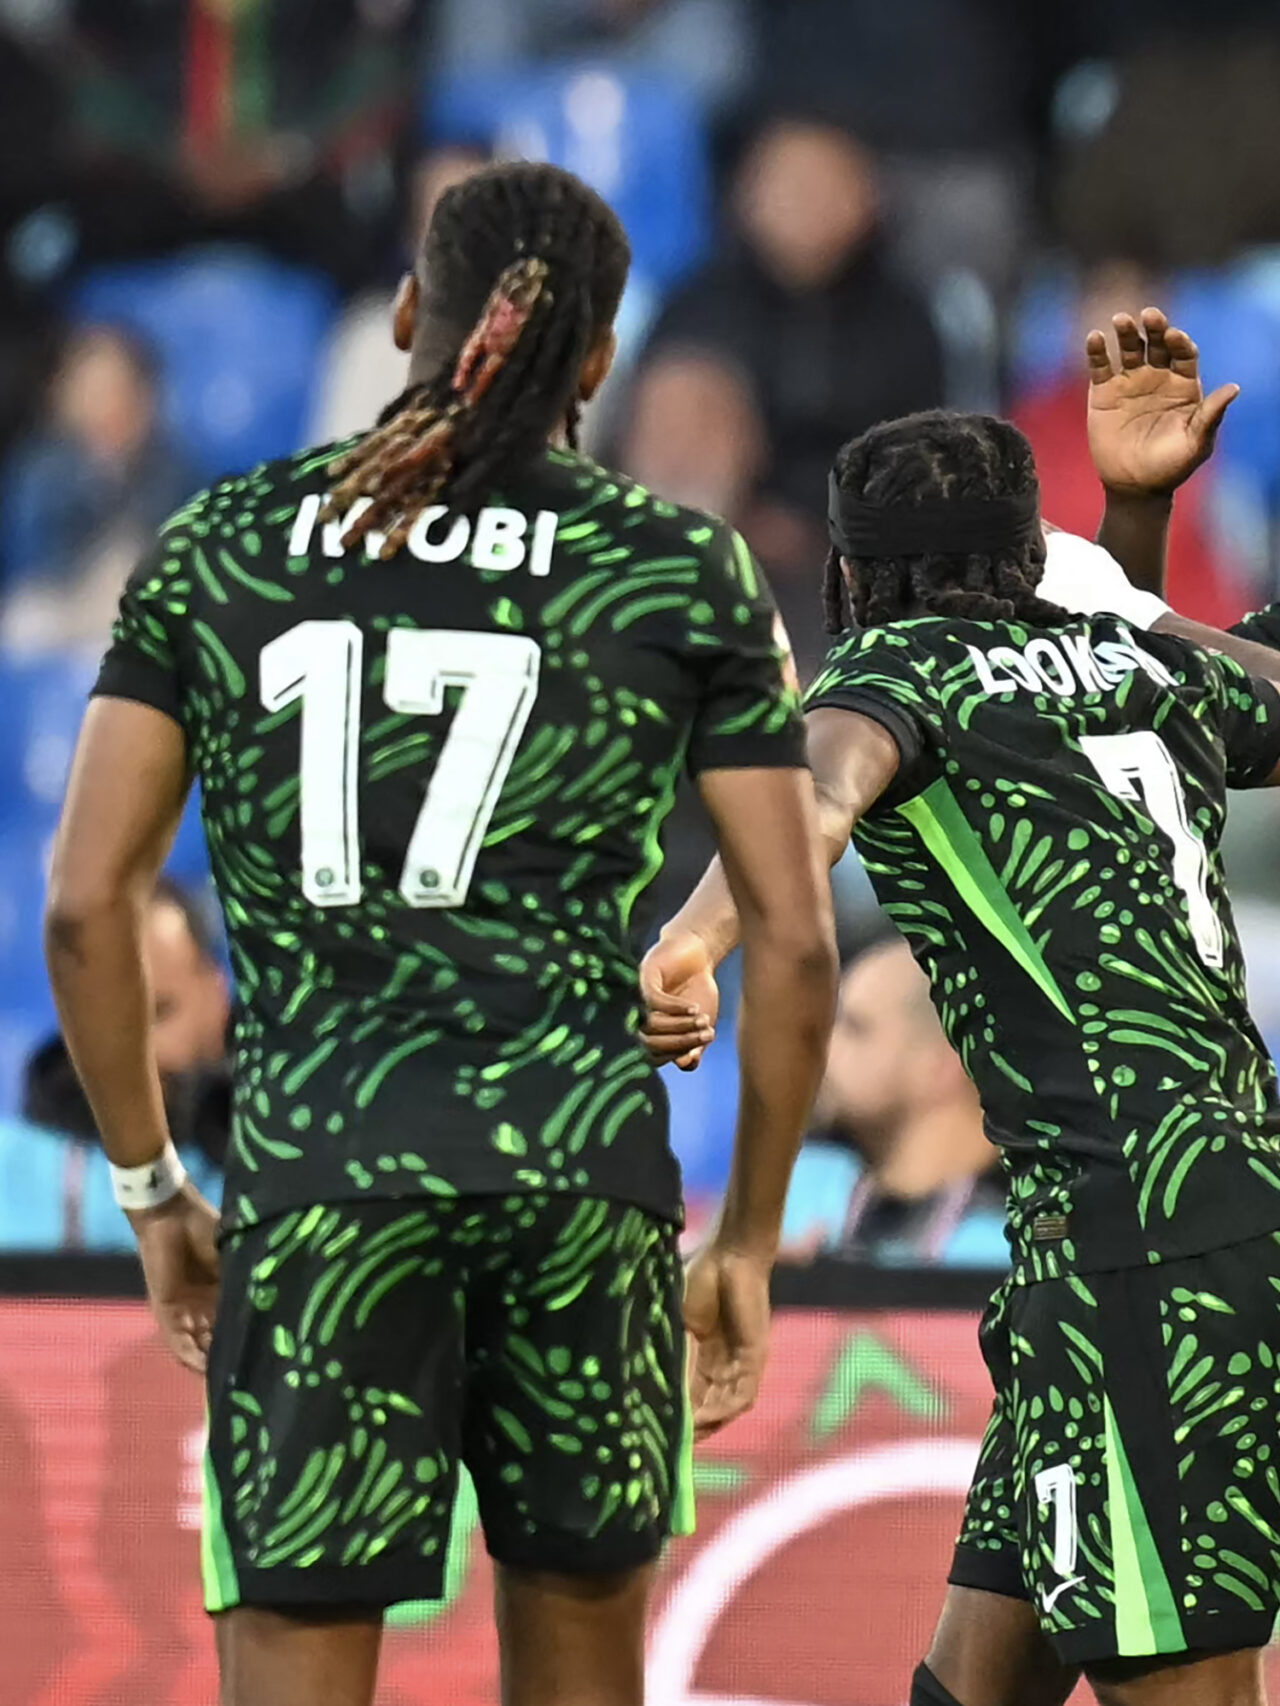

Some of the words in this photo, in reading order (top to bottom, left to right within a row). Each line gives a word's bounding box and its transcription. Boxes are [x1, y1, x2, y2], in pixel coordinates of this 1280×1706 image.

[259, 620, 541, 907] 17
[1078, 730, 1223, 968] 7
[1034, 1463, 1077, 1576] 7
